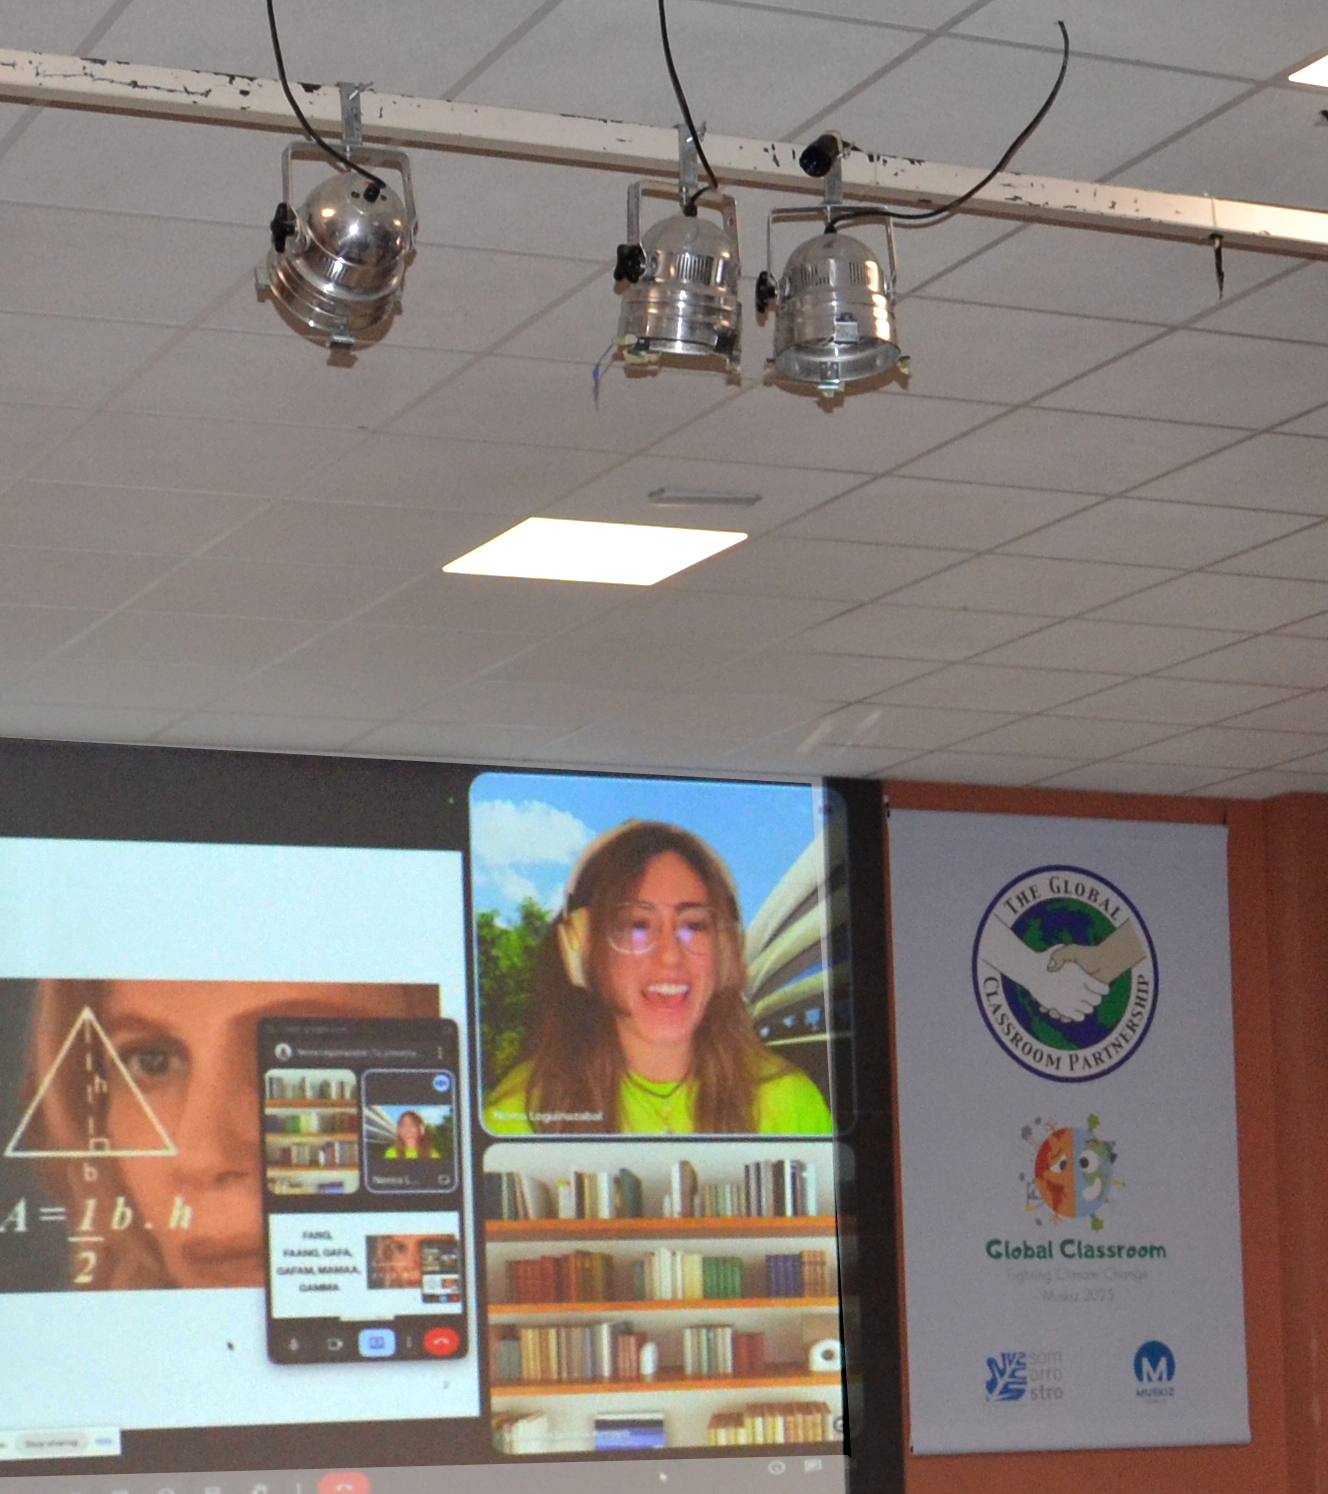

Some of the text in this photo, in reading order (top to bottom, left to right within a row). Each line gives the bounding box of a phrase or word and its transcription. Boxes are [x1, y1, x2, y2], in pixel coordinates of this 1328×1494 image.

[1003, 876, 1123, 921] THE GLOBAL
[983, 973, 1150, 1071] CLASSROOM PARTNERSHIP
[84, 1161, 98, 1182] b
[111, 1196, 133, 1232] b
[985, 1238, 1167, 1260] Global Classroom
[73, 1250, 96, 1284] 2
[1030, 1384, 1063, 1400] stro
[1136, 1386, 1175, 1397] MUSKIZ
